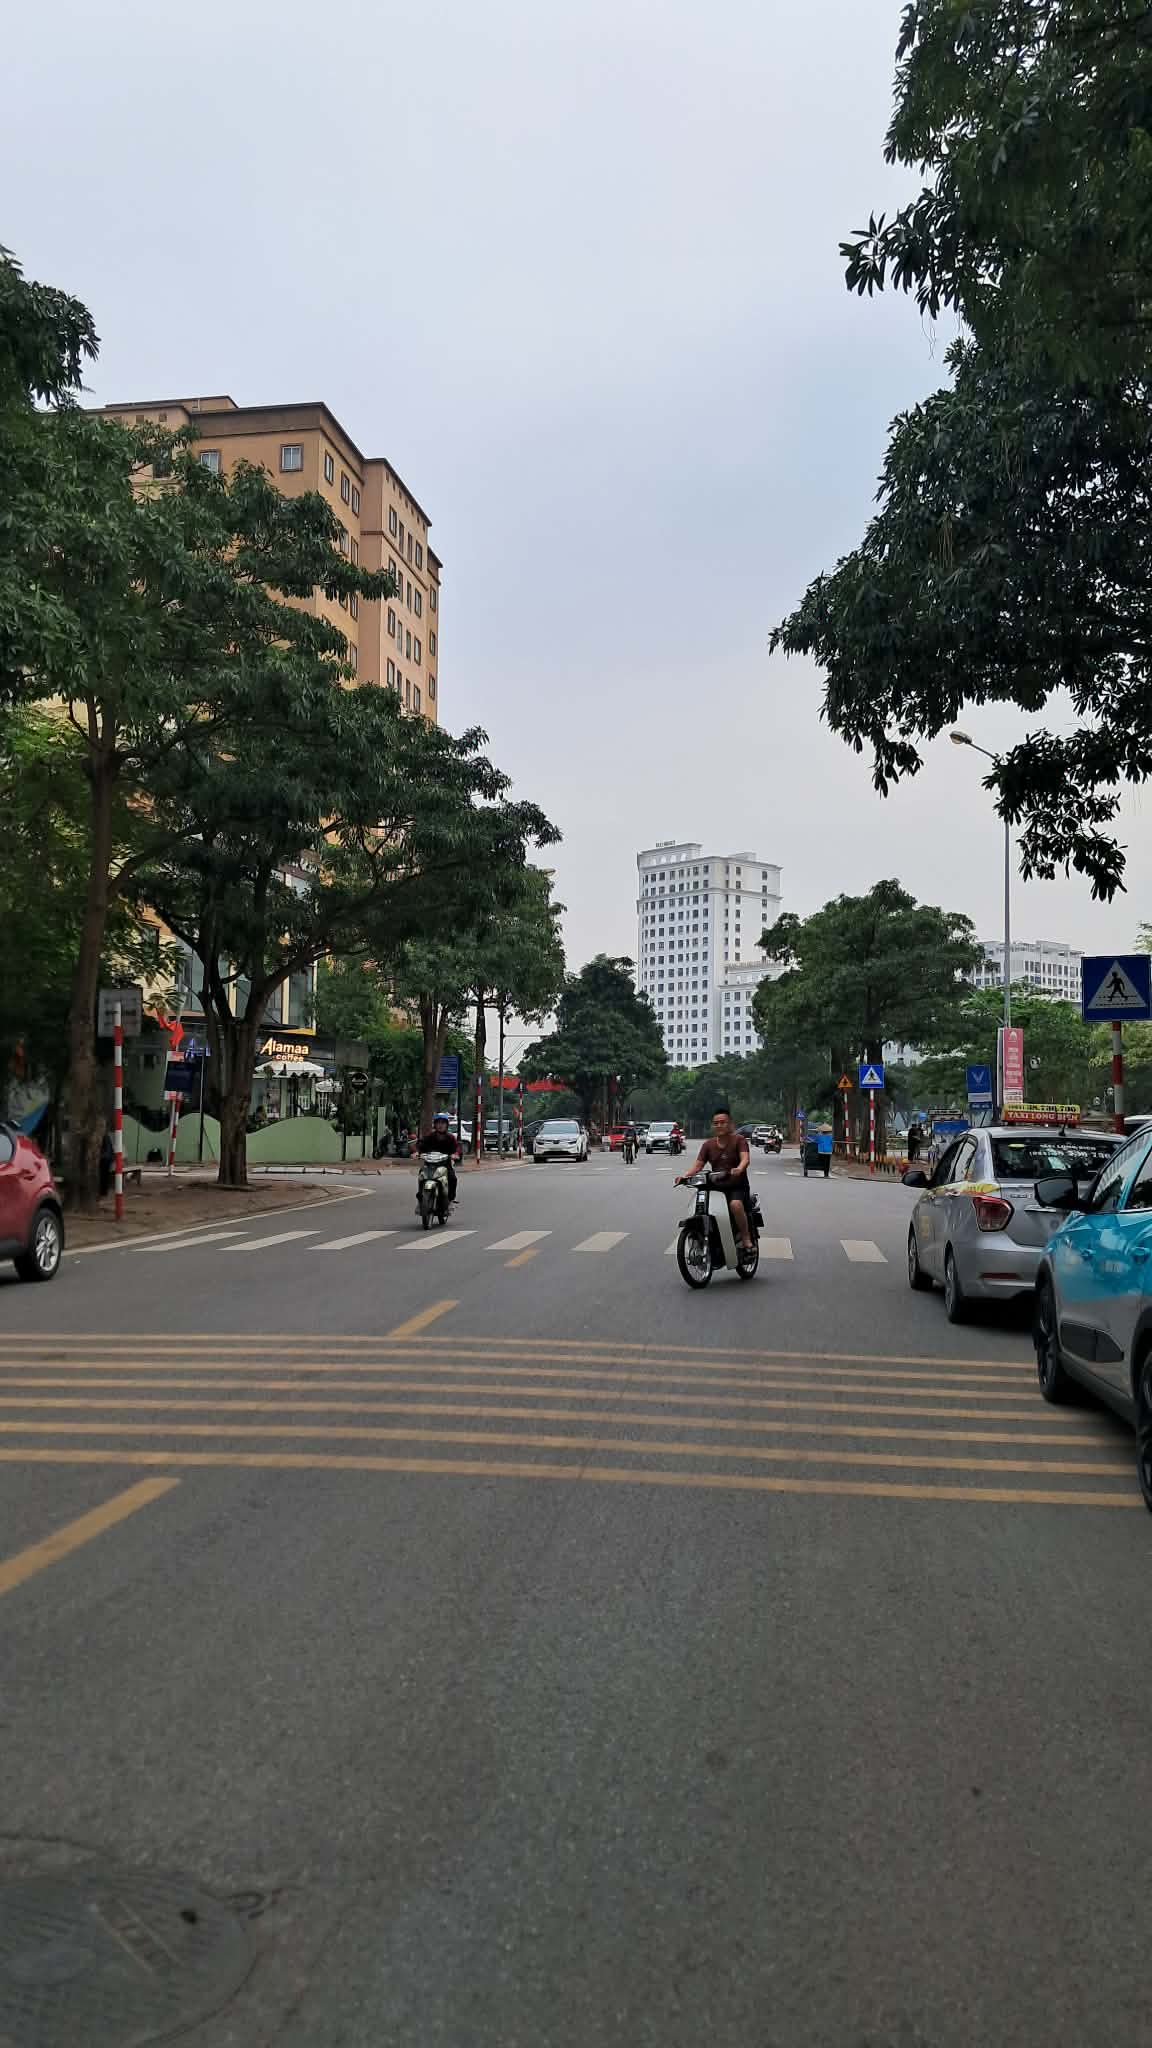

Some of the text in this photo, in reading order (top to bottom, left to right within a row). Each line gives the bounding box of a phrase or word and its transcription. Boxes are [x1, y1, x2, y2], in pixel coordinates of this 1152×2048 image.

[260, 1037, 309, 1055] Alamaa
[275, 1054, 304, 1062] coffee
[1008, 1111, 1029, 1119] TAXI
[1031, 1111, 1055, 1120] LONG
